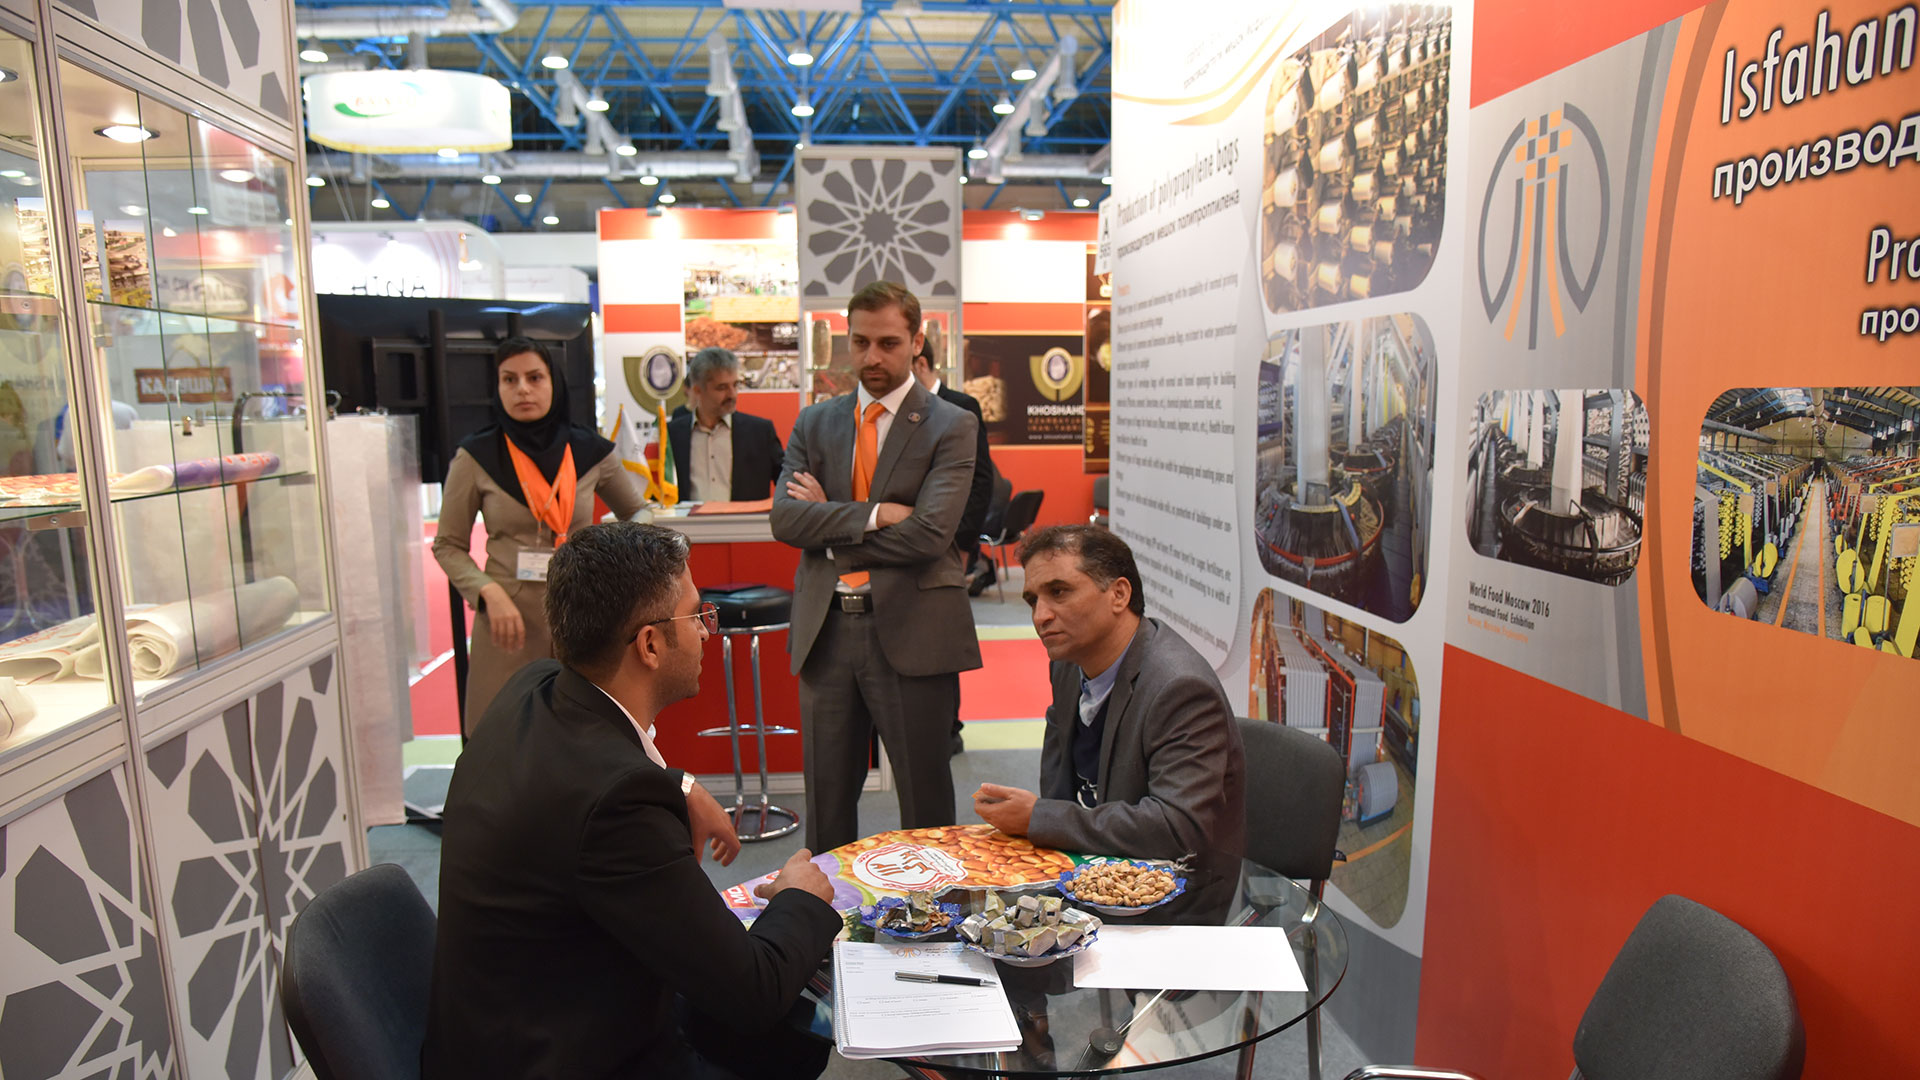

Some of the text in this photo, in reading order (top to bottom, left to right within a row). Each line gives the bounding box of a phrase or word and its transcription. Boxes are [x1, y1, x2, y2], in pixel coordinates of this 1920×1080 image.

[1720, 3, 1918, 125] Isfahan
[1117, 193, 1147, 228] Production
[1158, 153, 1214, 215] polypropylene
[1216, 137, 1240, 175] bags
[1468, 600, 1497, 618] International
[1497, 608, 1509, 622] Food
[1510, 612, 1535, 630] Exhibition
[1469, 581, 1550, 618] World Food Moscow 2016
